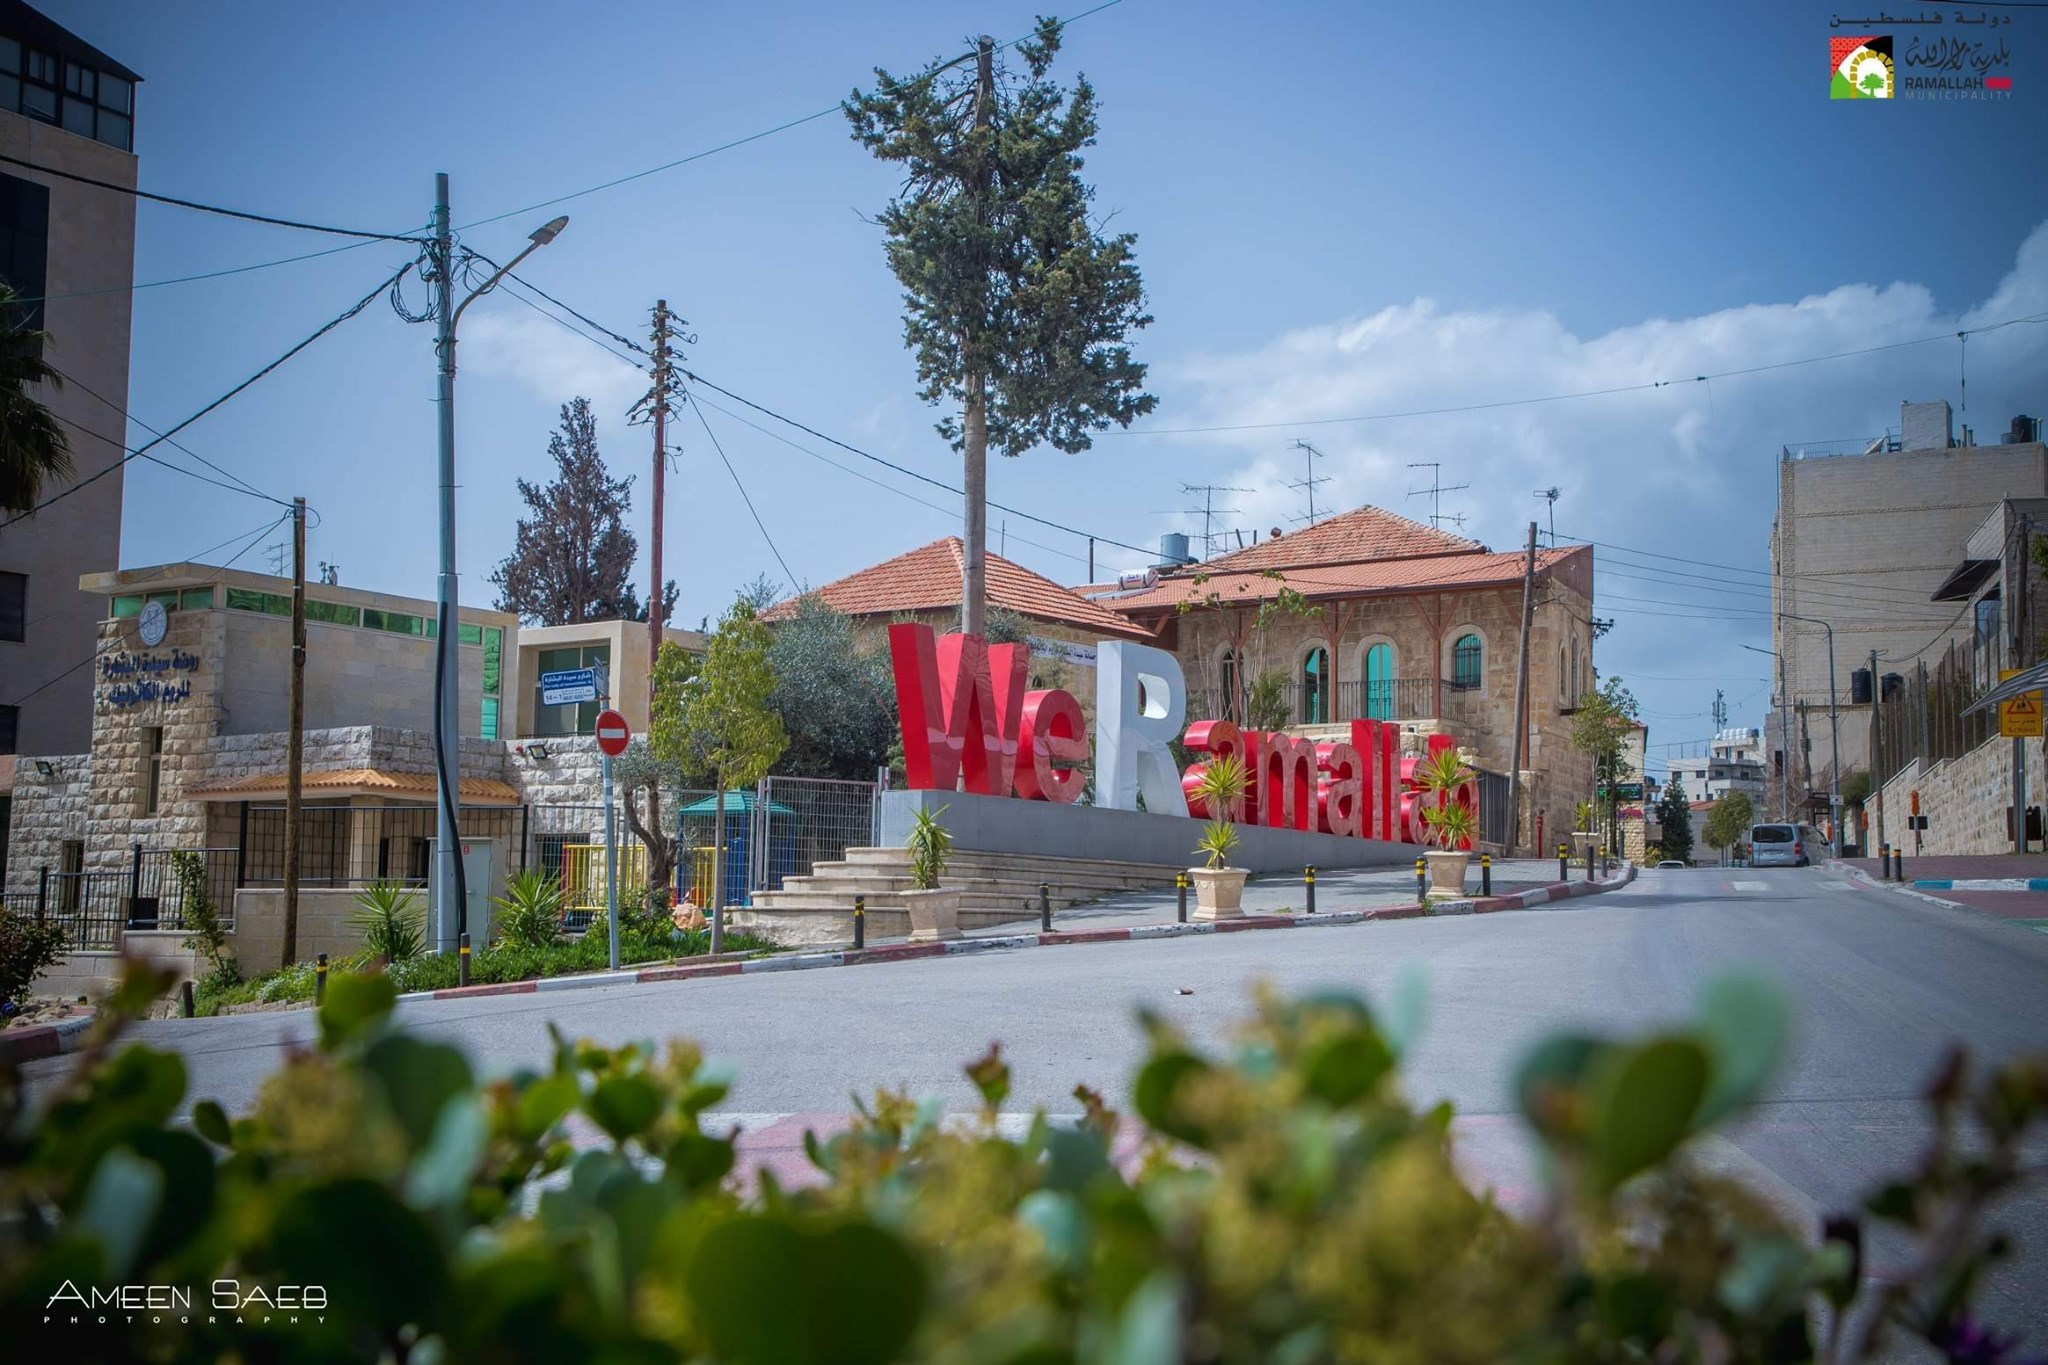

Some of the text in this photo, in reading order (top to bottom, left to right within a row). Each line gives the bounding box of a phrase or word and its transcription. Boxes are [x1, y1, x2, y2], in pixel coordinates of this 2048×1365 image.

[140, 652, 170, 677] سيدة
[172, 648, 199, 673] روضة
[887, 622, 1087, 802] We
[2008, 726, 2036, 734] School
